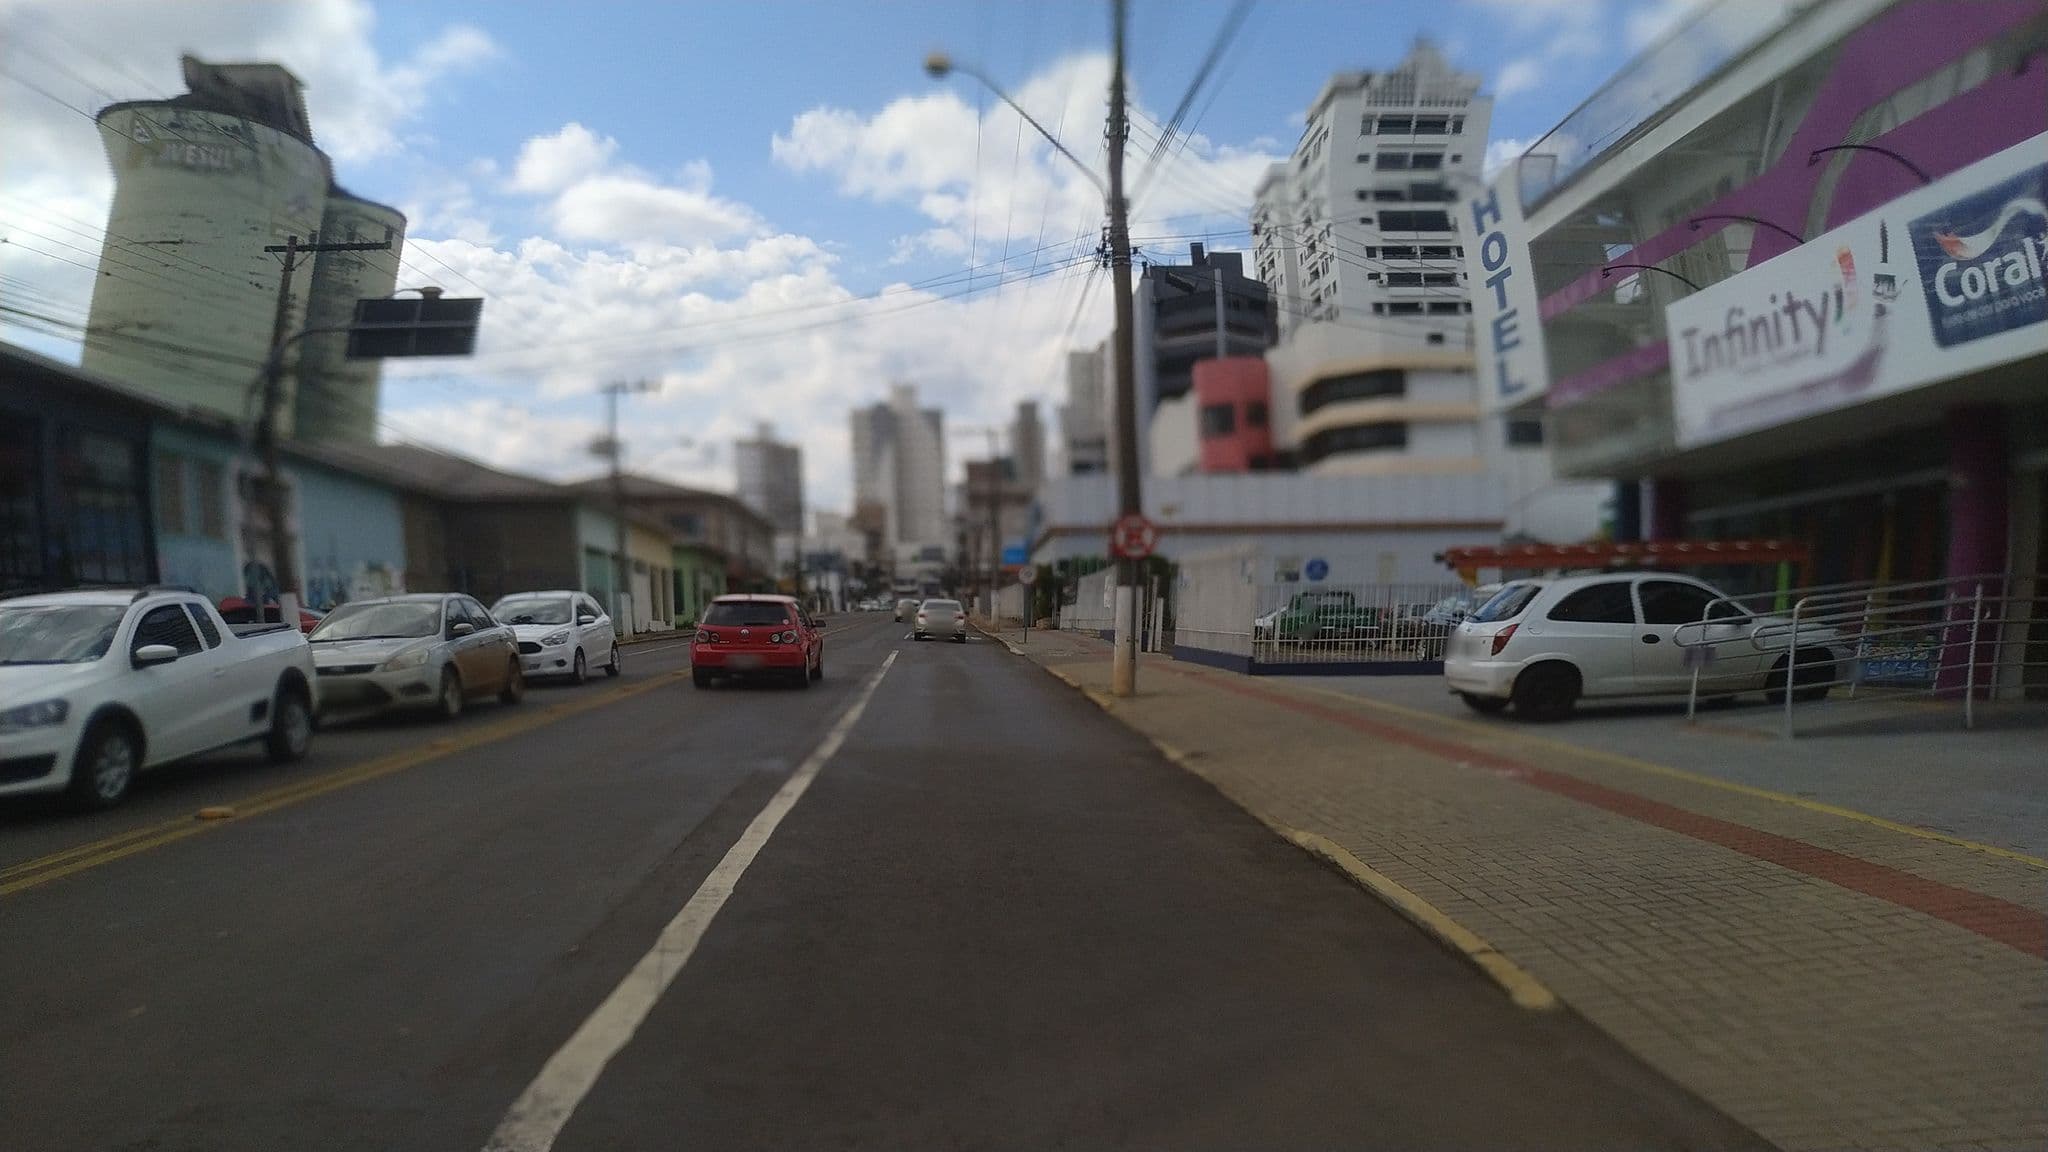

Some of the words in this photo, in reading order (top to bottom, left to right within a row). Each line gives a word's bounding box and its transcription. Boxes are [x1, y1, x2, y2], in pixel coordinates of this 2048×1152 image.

[1472, 188, 1526, 396] HOTEL
[1935, 237, 2042, 307] Coral
[1682, 291, 1830, 379] Infinity
